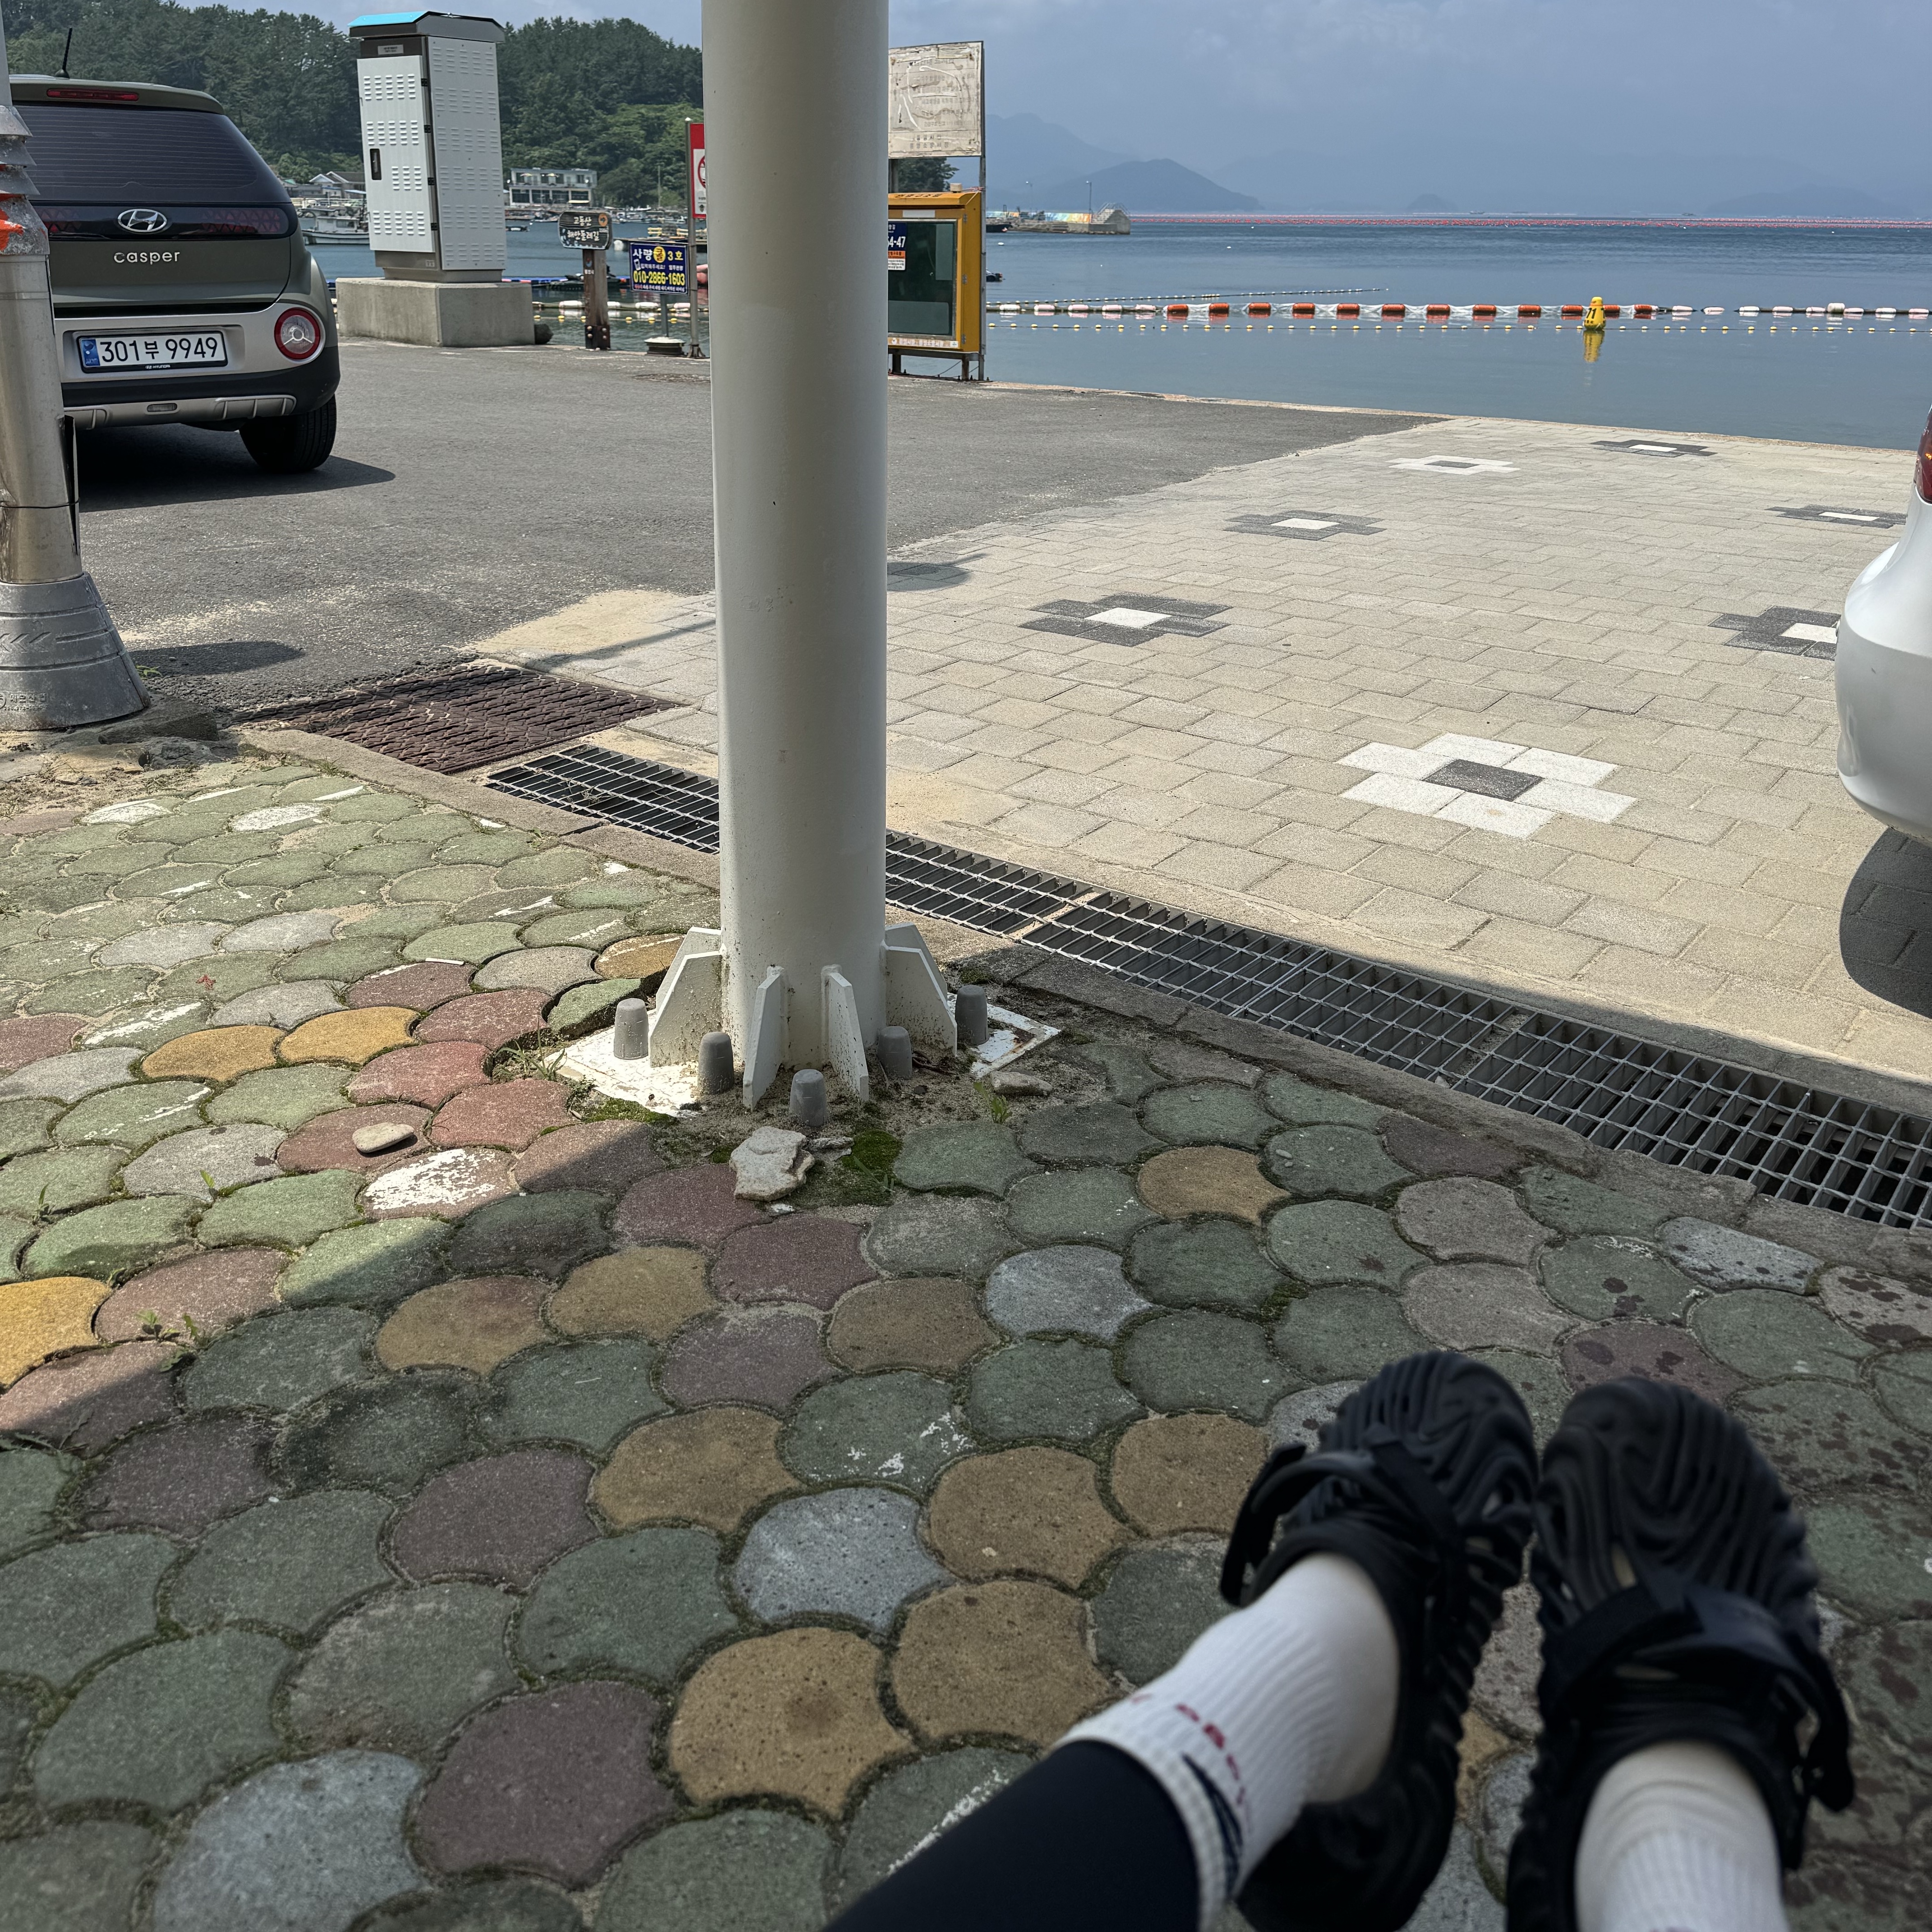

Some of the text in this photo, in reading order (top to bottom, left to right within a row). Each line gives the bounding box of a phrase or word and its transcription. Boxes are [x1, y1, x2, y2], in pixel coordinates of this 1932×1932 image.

[573, 216, 592, 226] 고동산
[567, 230, 600, 241] 해안둘레길
[114, 251, 180, 265] casper
[633, 270, 685, 286] 010-2866-1603
[100, 336, 218, 363] 301부 9949
